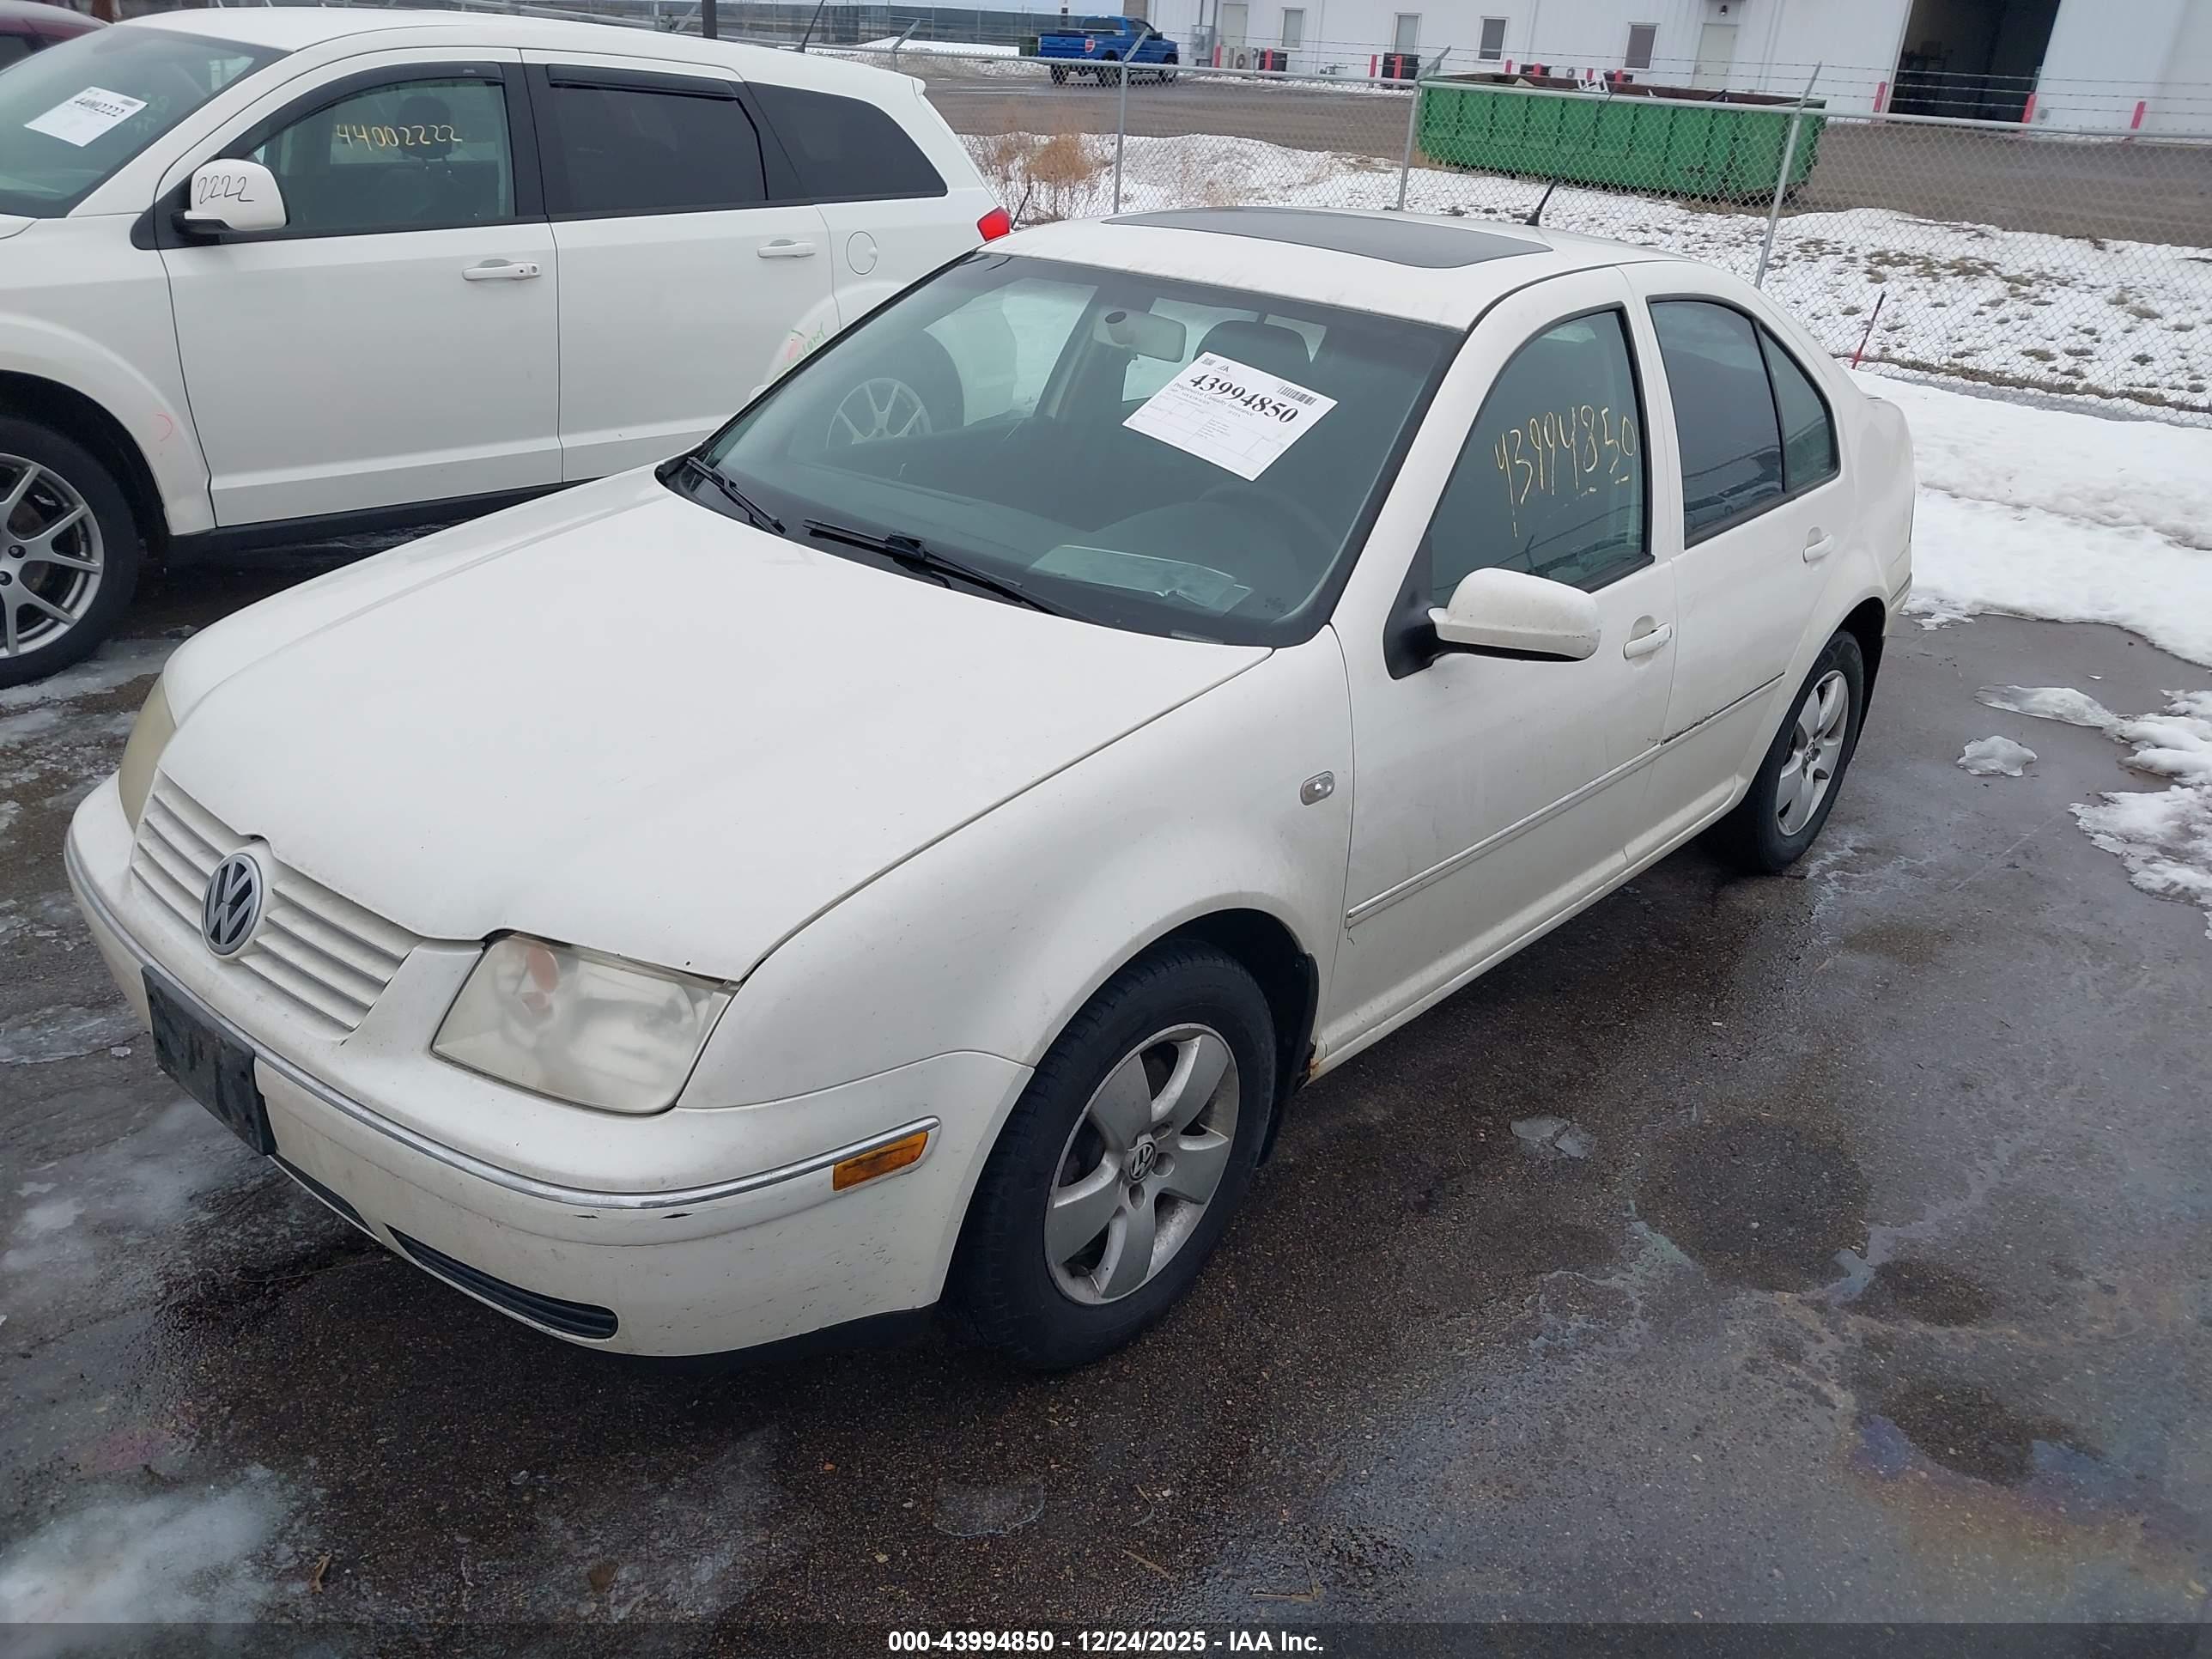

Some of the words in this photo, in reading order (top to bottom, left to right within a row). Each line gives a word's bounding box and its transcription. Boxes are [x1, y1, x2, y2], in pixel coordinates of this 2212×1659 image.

[336, 124, 464, 151] 44002222
[197, 174, 255, 205] 2222
[1188, 373, 1299, 423] 43994850
[1493, 404, 1638, 526] 43994850
[204, 854, 261, 954] VW
